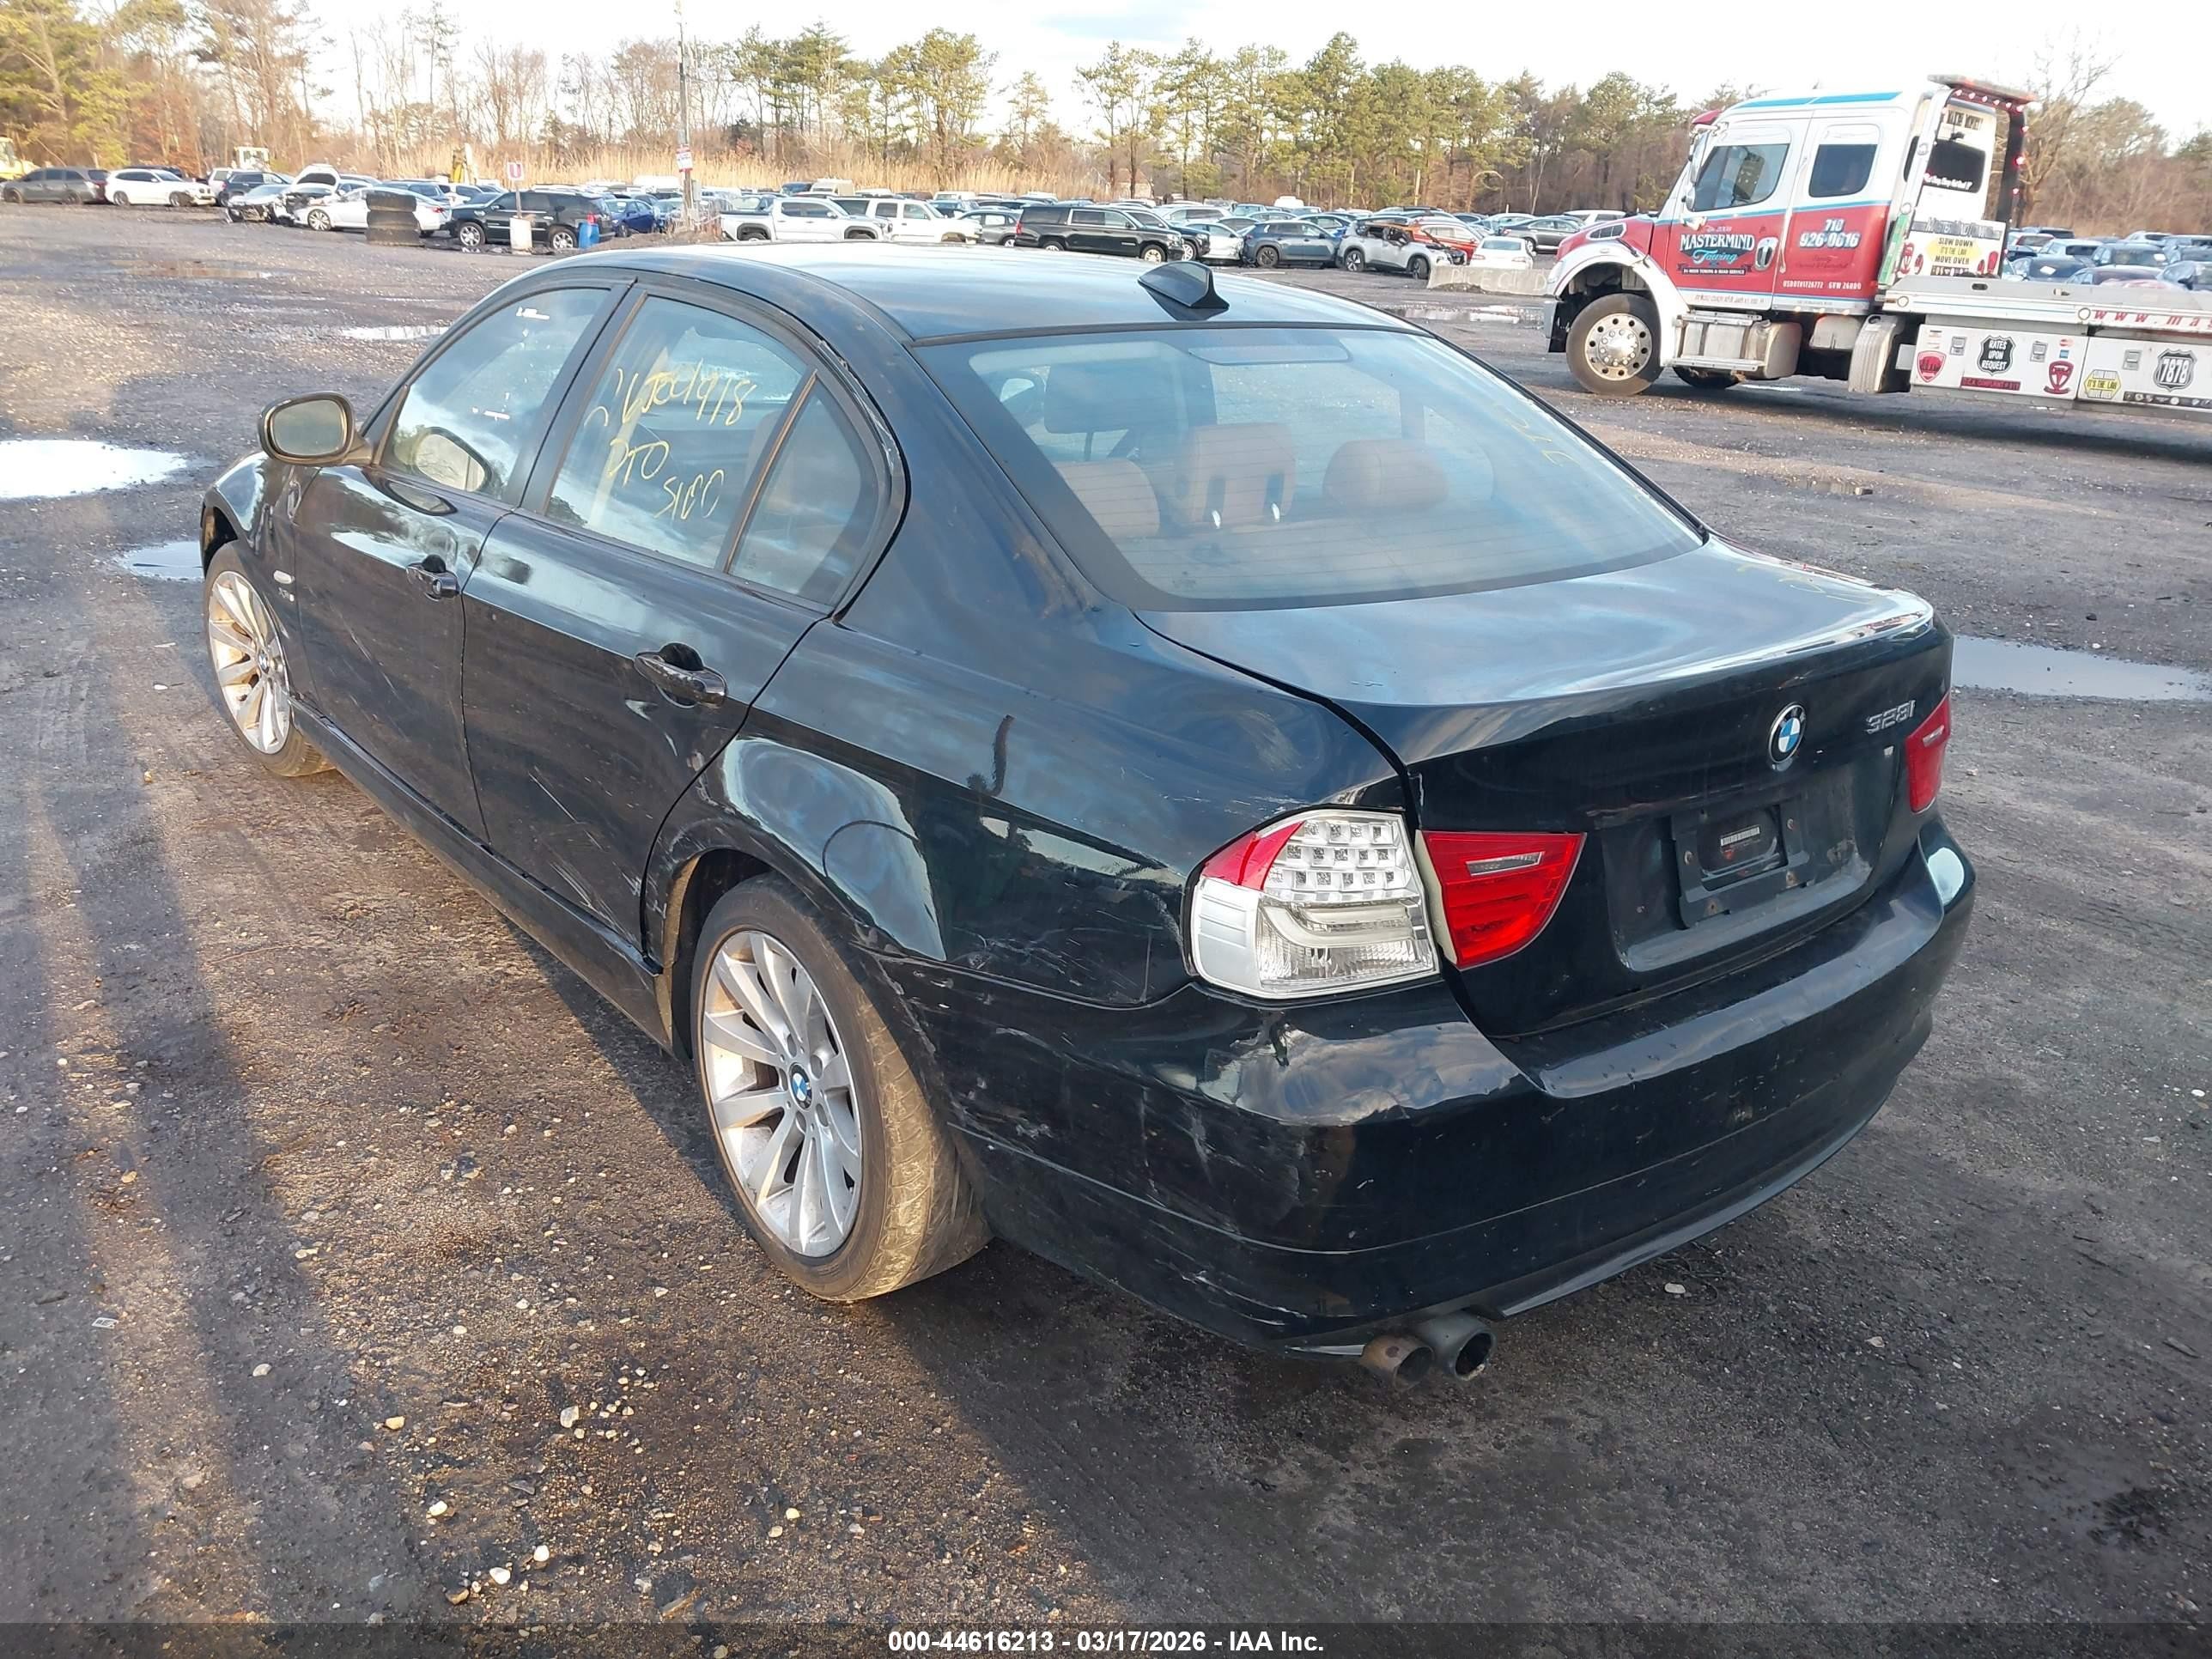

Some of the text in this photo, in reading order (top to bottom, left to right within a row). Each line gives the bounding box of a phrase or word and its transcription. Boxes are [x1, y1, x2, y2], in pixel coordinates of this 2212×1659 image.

[1680, 234, 1755, 252] MASTERMIND
[1938, 237, 1973, 247] SLOW DOWN
[1692, 249, 1738, 264] Towing
[1935, 255, 1952, 264] MOVE
[1988, 339, 2008, 350] RATES
[1988, 350, 2003, 360] UPON
[1981, 360, 2008, 371] REQUEST
[2160, 358, 2190, 385] 7878
